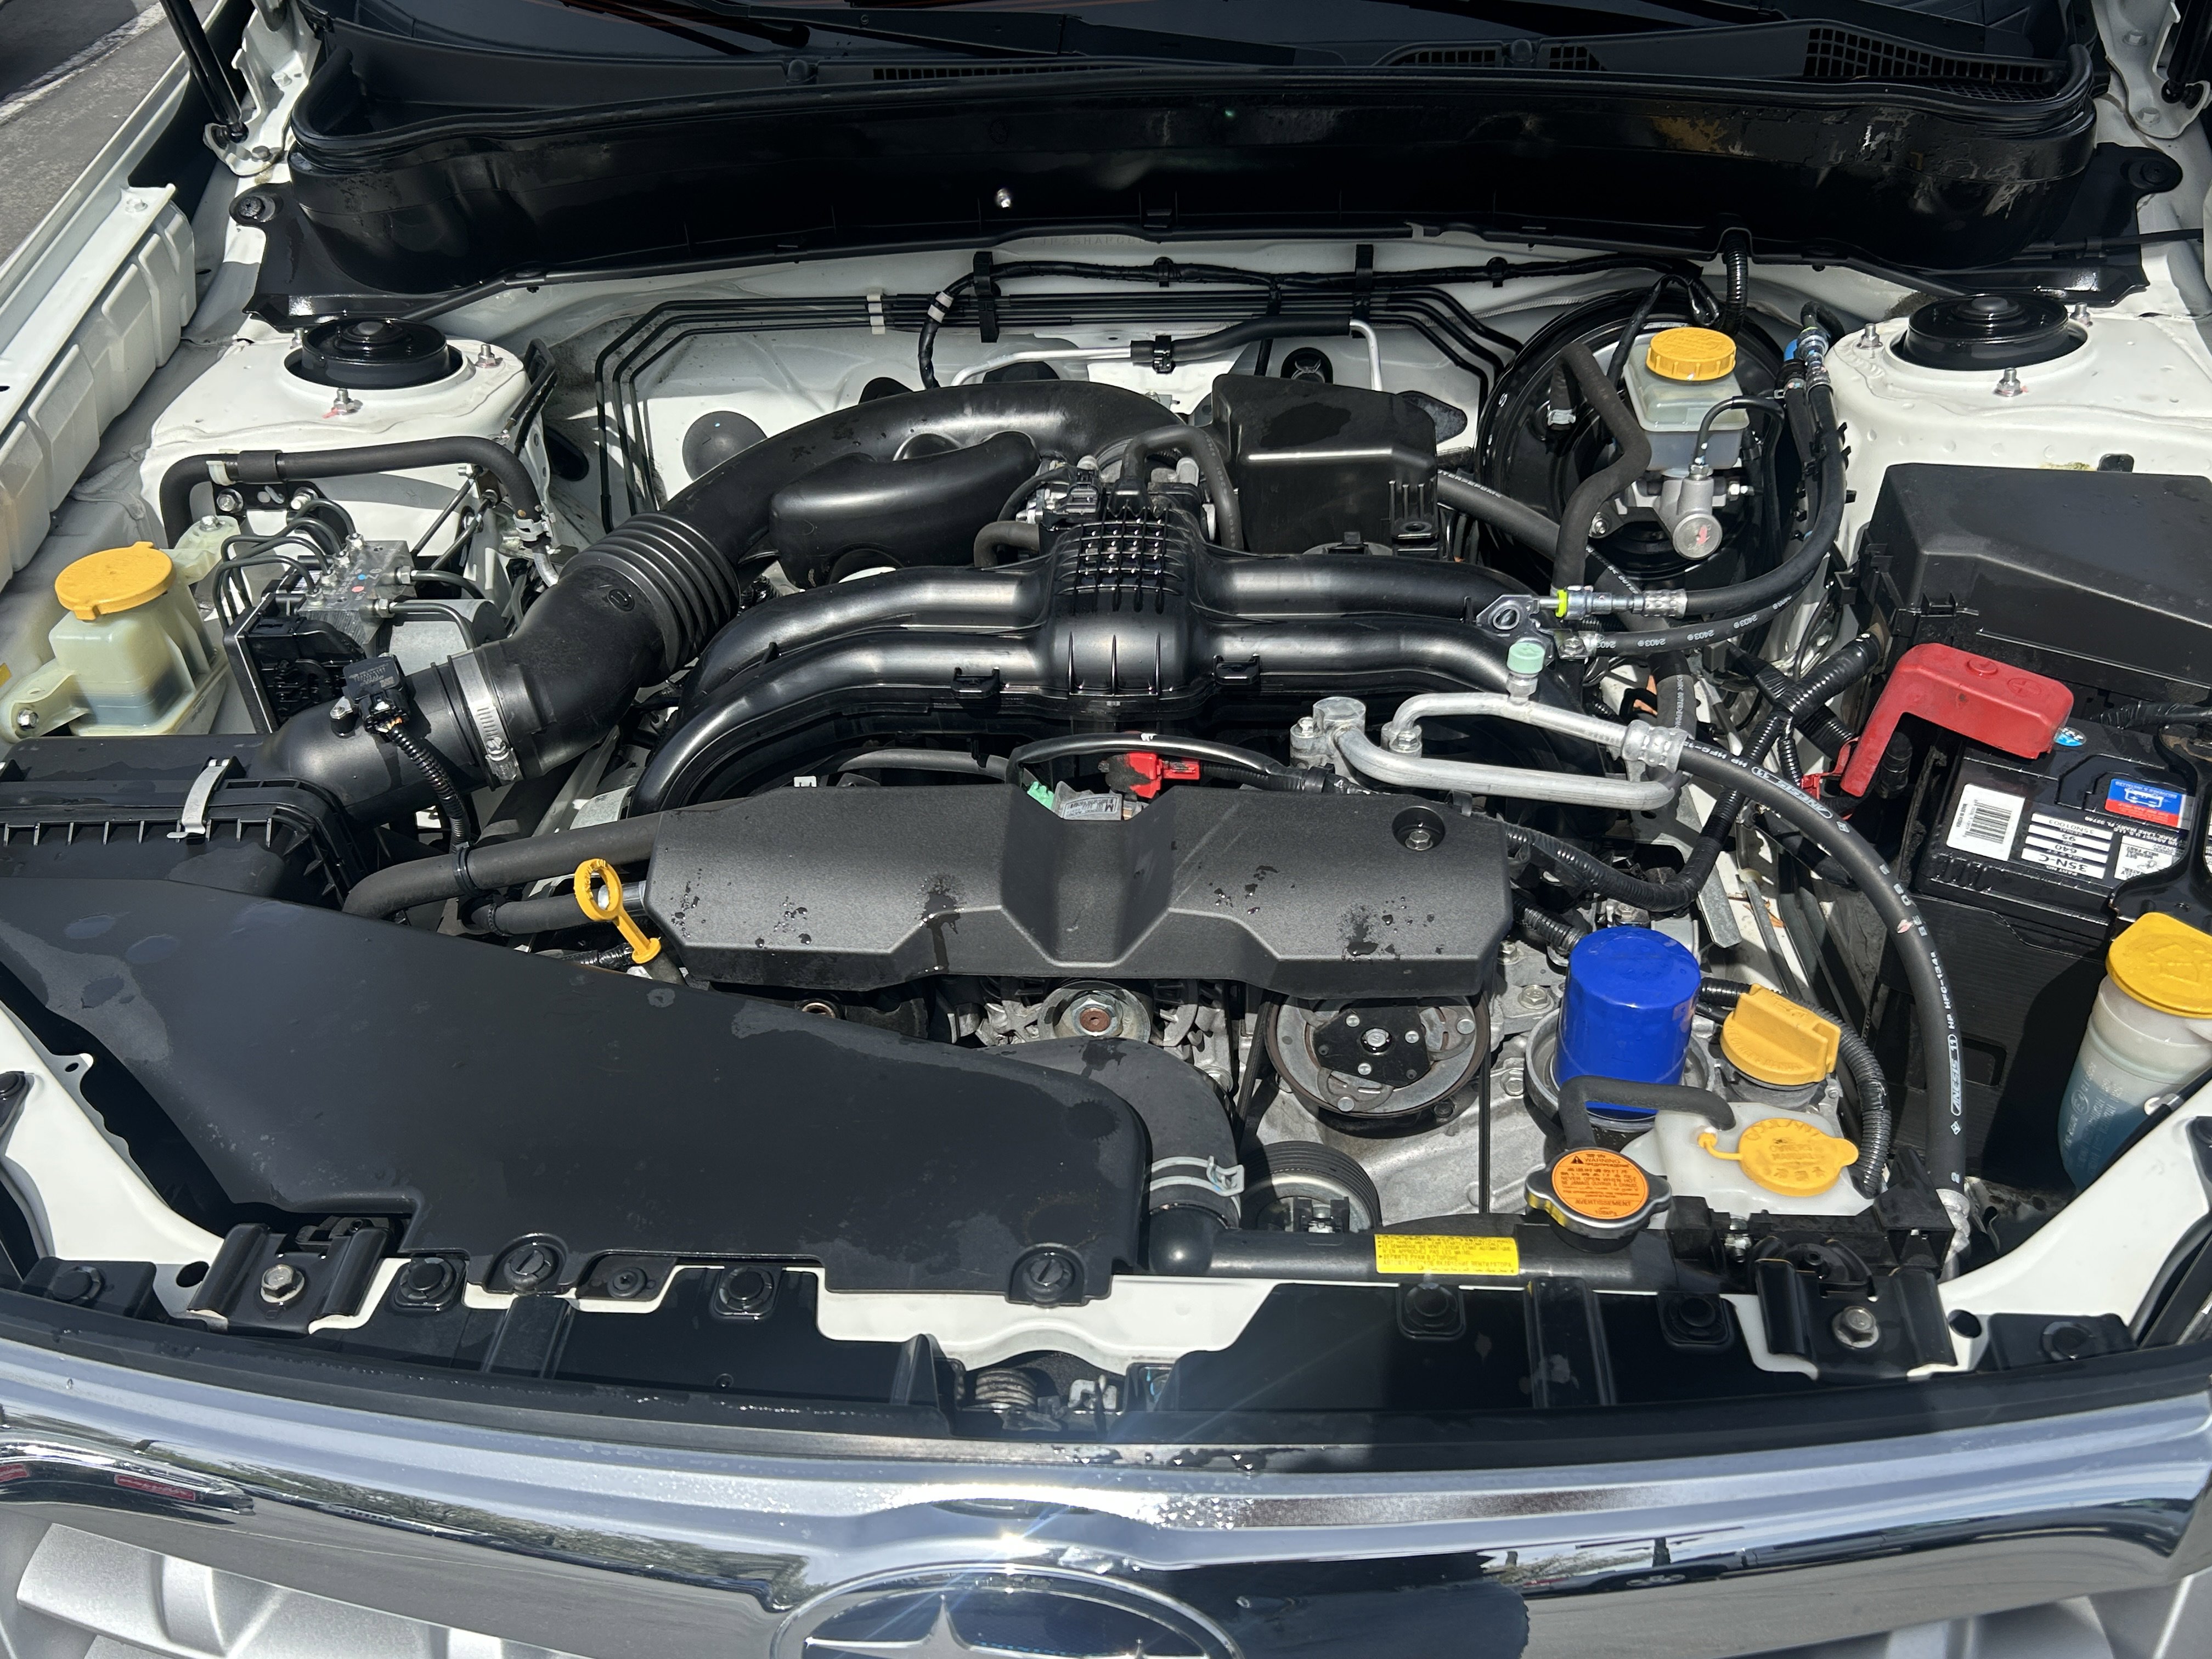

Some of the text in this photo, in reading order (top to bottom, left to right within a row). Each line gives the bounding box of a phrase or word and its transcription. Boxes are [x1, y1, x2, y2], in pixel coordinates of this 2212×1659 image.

[1740, 614, 1758, 627] 2403
[1692, 629, 1714, 640] 2403
[1644, 638, 1666, 647] 2403
[1730, 754, 1748, 769] HP
[2061, 833, 2076, 842] 95
[2142, 834, 2166, 844] ASSIST
[2054, 844, 2078, 855] 640
[2038, 853, 2088, 873] 35N-C
[2058, 868, 2078, 876] PART
[1946, 1013, 1955, 1029] HP
[1949, 1039, 1957, 1051] 11
[1952, 1059, 1960, 1109] ANESIS
[1951, 1171, 1960, 1183] 2
